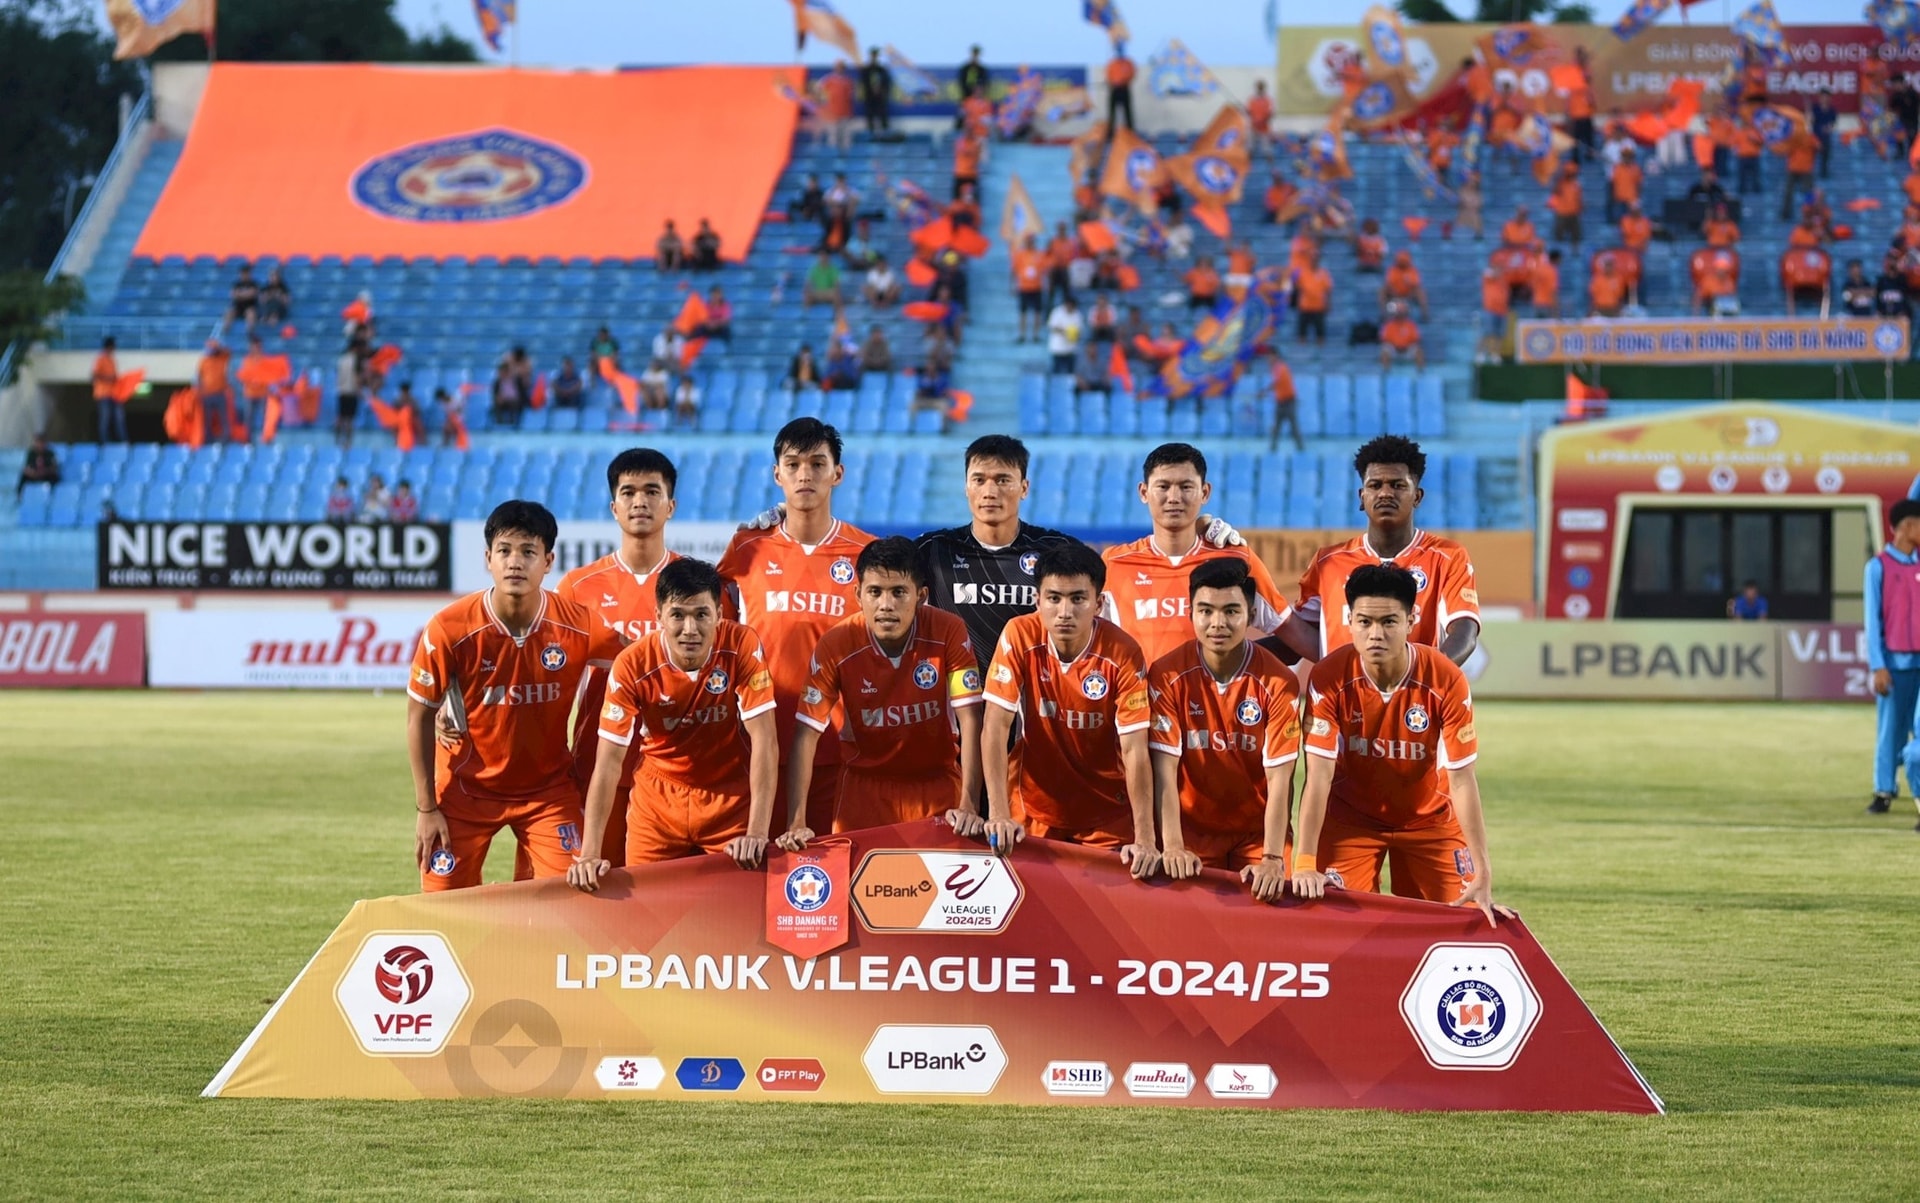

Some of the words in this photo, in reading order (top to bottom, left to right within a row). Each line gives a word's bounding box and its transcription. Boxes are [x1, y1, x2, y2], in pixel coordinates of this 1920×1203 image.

[108, 524, 228, 568] NICE
[244, 524, 441, 569] WORLD
[791, 591, 846, 617] SHB
[980, 583, 1037, 607] SHB
[1160, 597, 1192, 618] SH
[627, 619, 664, 641] SH
[0, 620, 117, 673] BOLA
[1540, 642, 1766, 680] LPBANK
[508, 682, 561, 706] SHB
[886, 700, 941, 728] SHB
[1372, 737, 1426, 761] SHB
[865, 885, 918, 898] LPBank
[777, 916, 793, 926] SHB
[795, 915, 827, 926] DANANG
[828, 915, 838, 926] FC
[942, 905, 990, 915] V.LEAGUE
[945, 916, 992, 926] 2024/25
[555, 955, 770, 990] LPBANK
[782, 955, 1036, 992] V.LEAGUE
[1049, 958, 1076, 993] 1
[1090, 974, 1103, 984] -
[1117, 960, 1331, 1002] 2024/25
[374, 1014, 433, 1035] VPF
[887, 1050, 966, 1071] LPBank
[777, 1071, 796, 1080] FPT
[798, 1071, 820, 1082] Play
[1068, 1068, 1103, 1082] SHB
[1133, 1069, 1186, 1083] muRata
